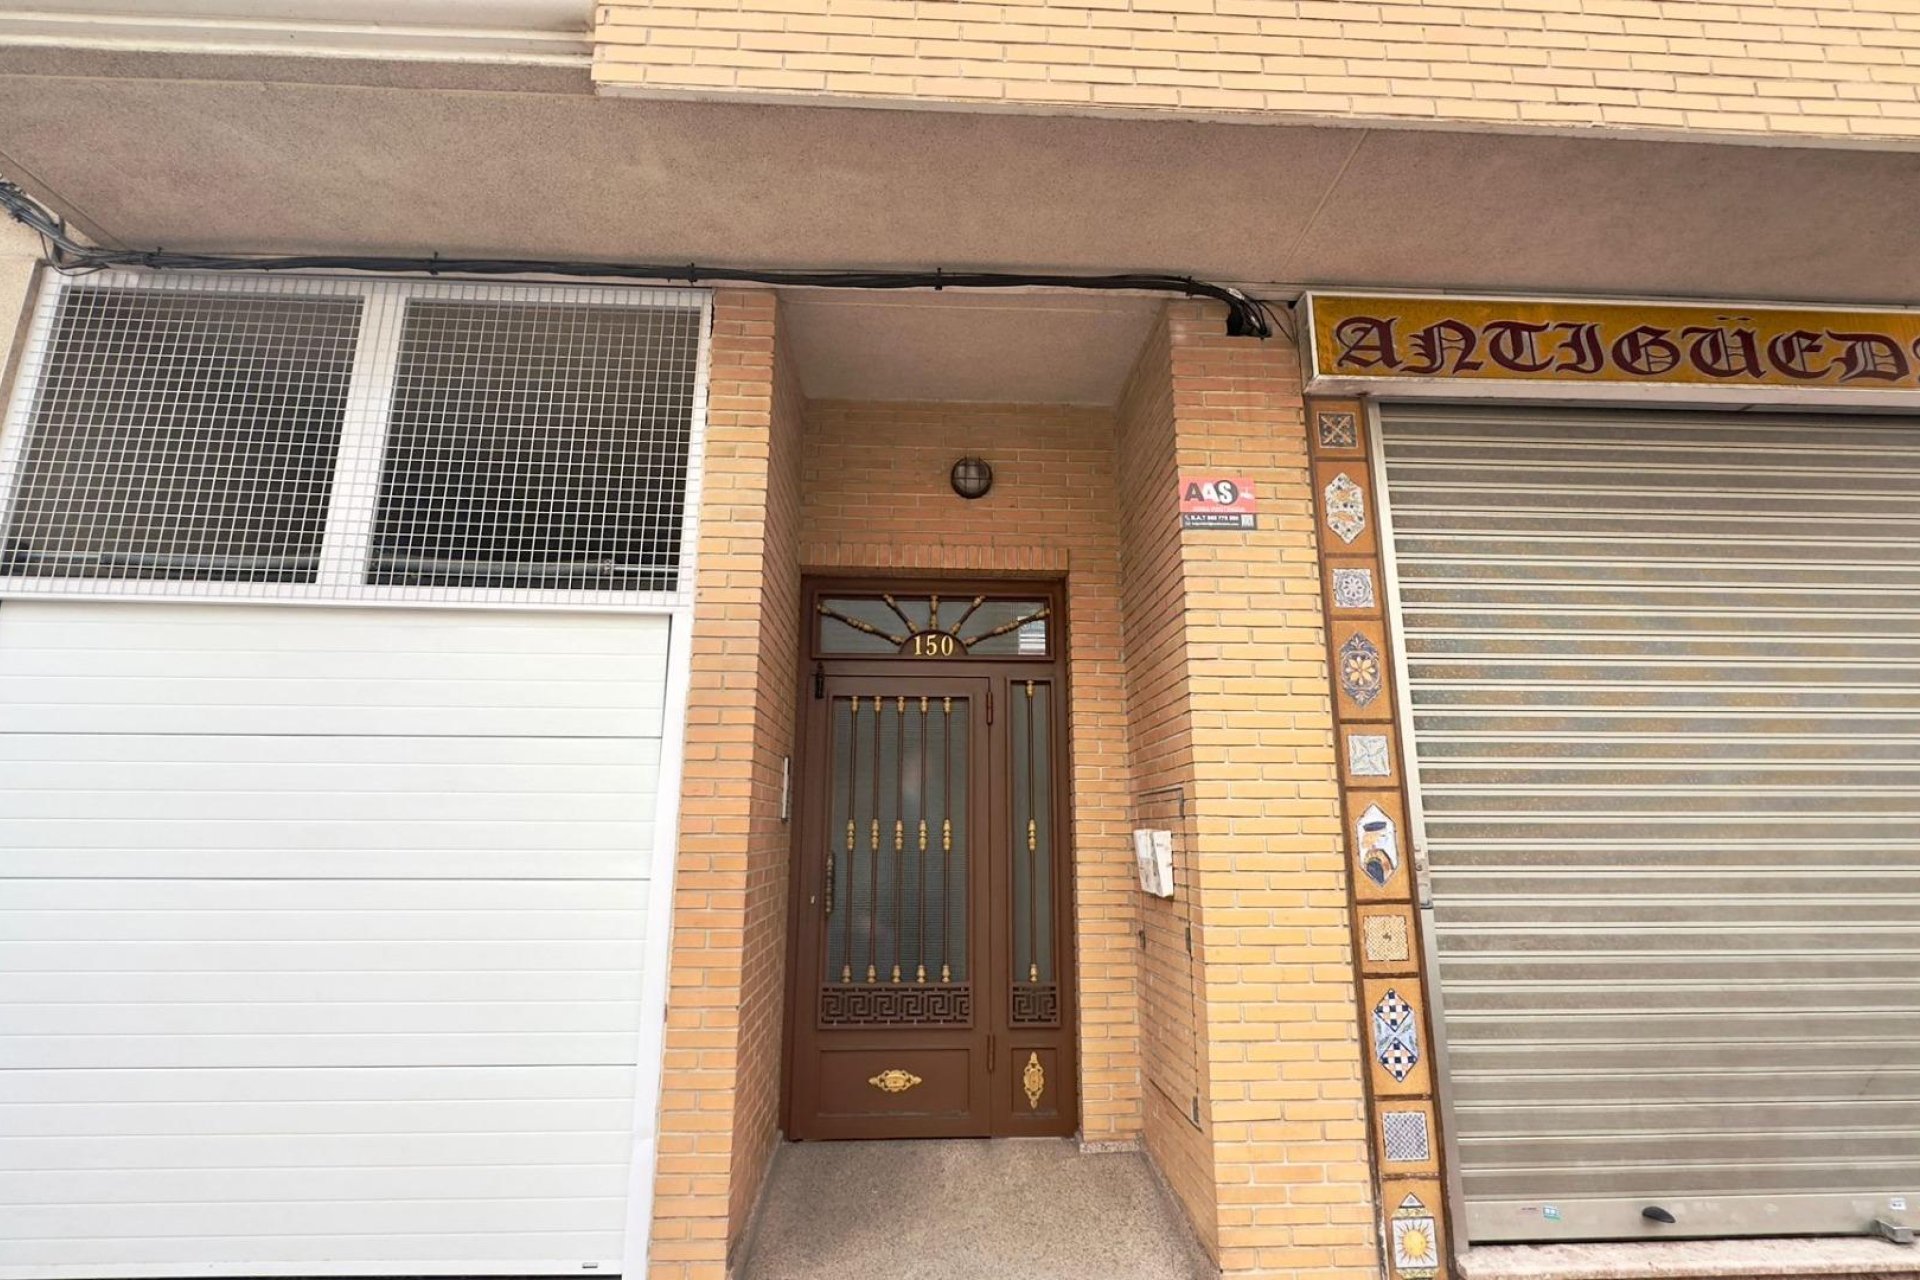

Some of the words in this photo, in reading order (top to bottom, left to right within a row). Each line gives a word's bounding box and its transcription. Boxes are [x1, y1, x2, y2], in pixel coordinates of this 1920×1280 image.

[1336, 316, 1920, 381] ANTIGÜED
[1184, 481, 1235, 504] AAS
[914, 634, 954, 656] 150
